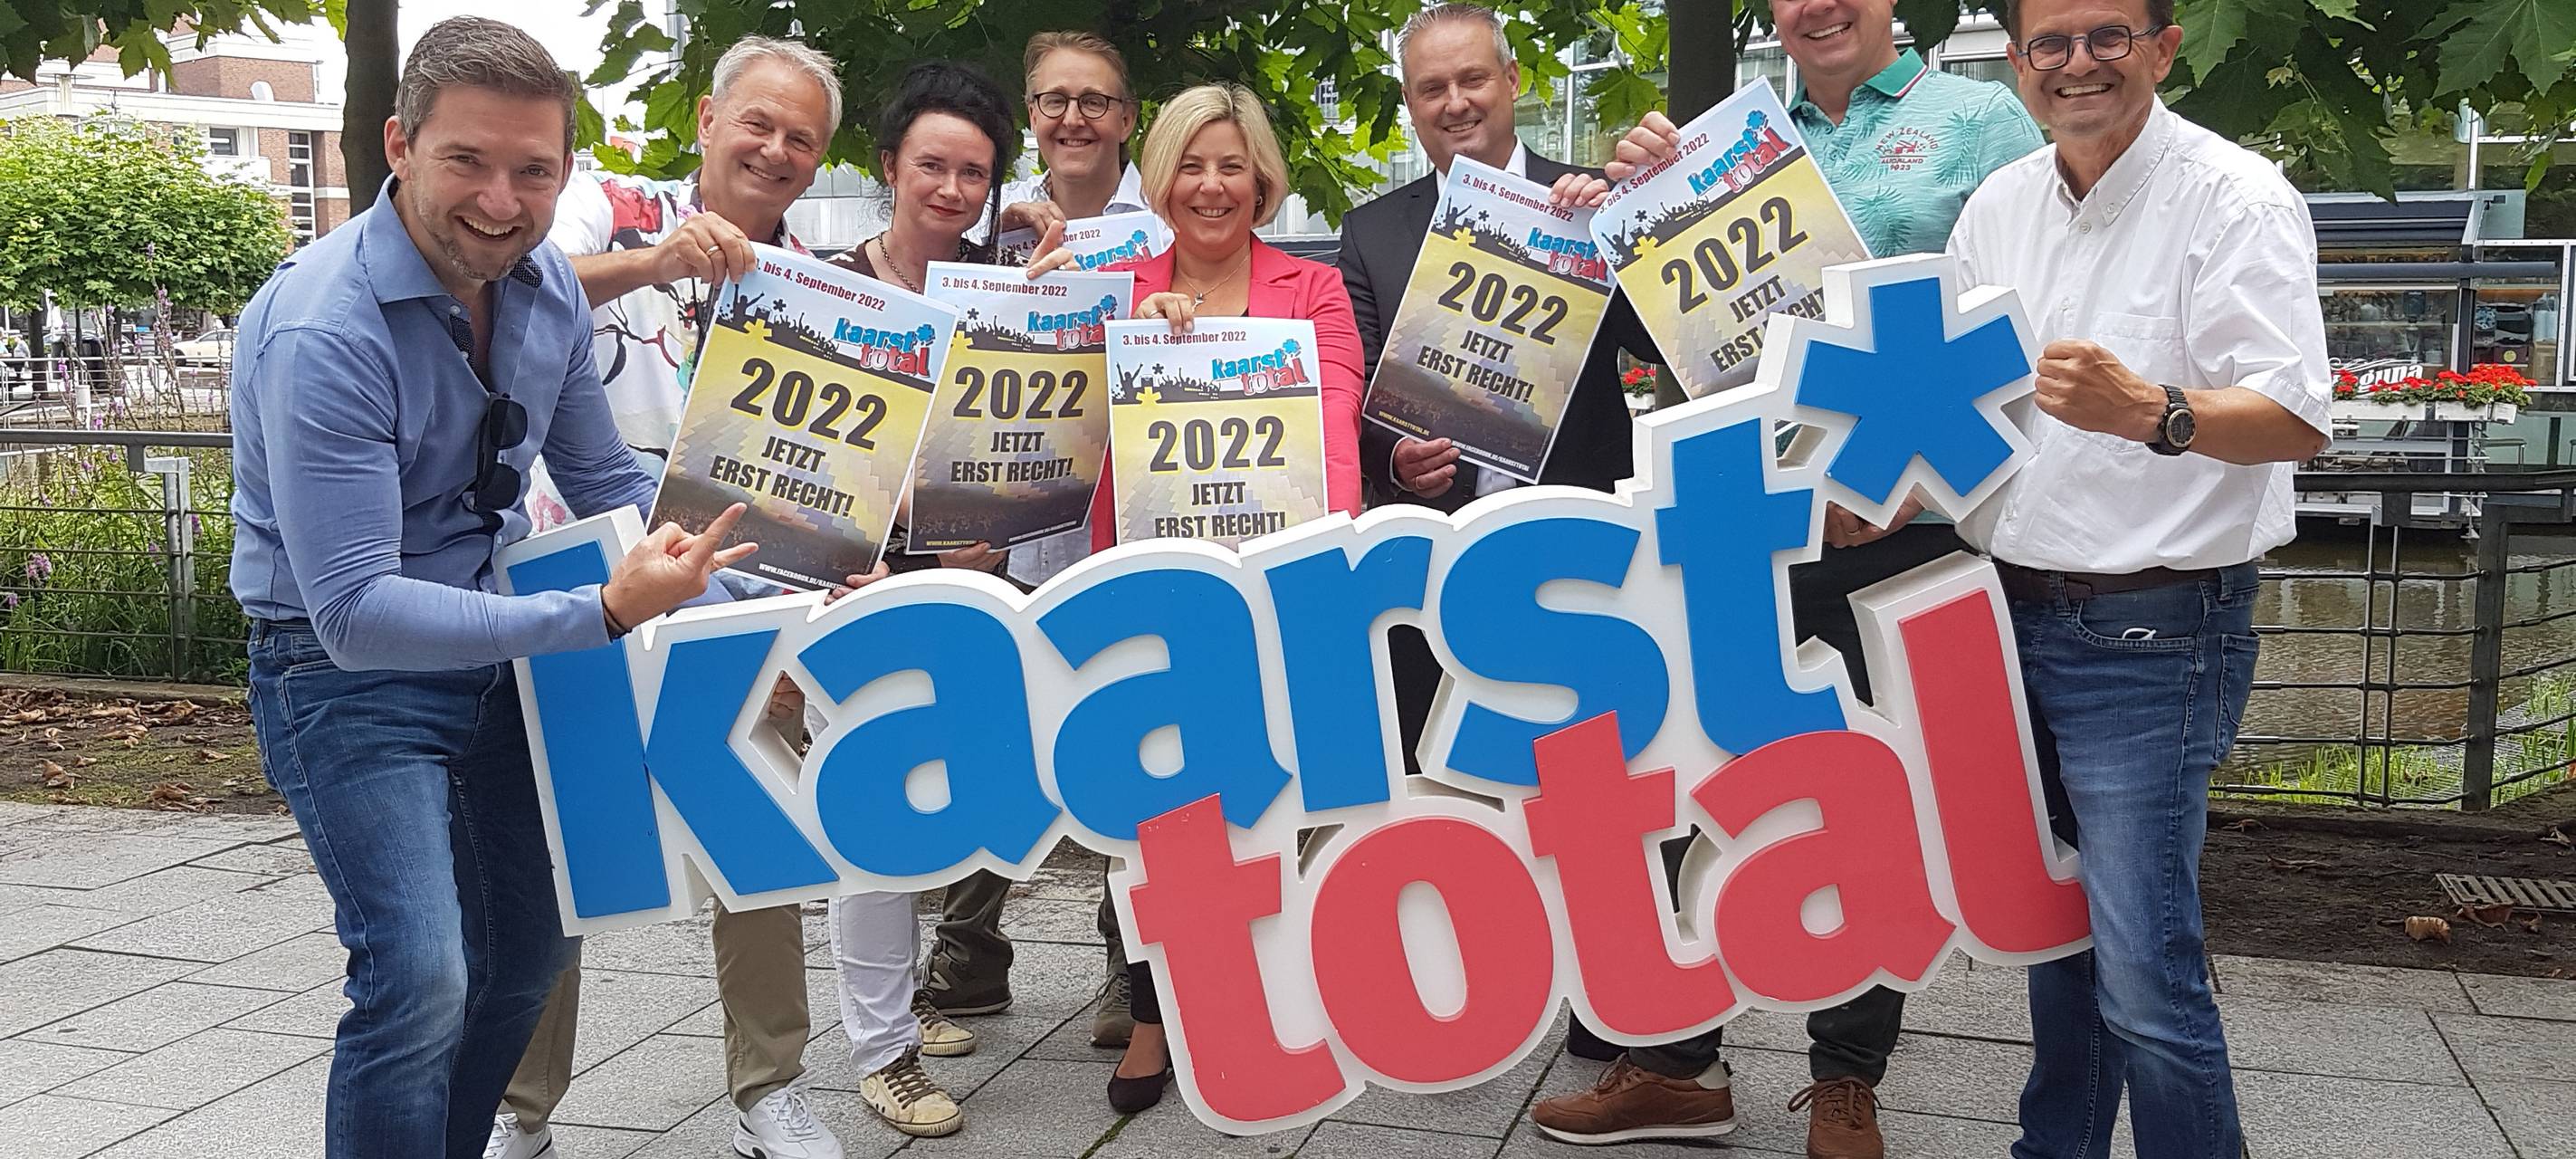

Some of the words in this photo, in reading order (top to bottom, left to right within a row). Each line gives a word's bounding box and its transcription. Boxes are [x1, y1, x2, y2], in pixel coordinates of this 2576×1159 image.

[1875, 130, 1895, 151] NEW
[1900, 127, 1939, 149] ZEALAND
[1608, 192, 1621, 207] bis
[1622, 182, 1632, 196] 4.
[1630, 151, 1684, 189] September
[1683, 133, 1710, 155] 2022
[1687, 129, 1764, 196] kaarst
[1722, 126, 1792, 193] total
[1463, 174, 1471, 186] 3.
[1473, 177, 1488, 191] bis
[1489, 183, 1496, 195] 4.
[1498, 187, 1549, 214] September
[1550, 206, 1574, 222] 2022
[1079, 228, 1101, 240] 2022
[1528, 227, 1598, 259] kaarst
[1548, 251, 1608, 282] total
[1660, 196, 1809, 314] 2022
[763, 261, 782, 276] bis
[783, 266, 793, 281] 4.
[796, 273, 857, 302] September
[858, 292, 886, 311] 2022
[942, 276, 950, 288] 3.
[953, 278, 969, 290] bis
[971, 279, 979, 291] 4.
[983, 280, 1040, 296] September
[1042, 285, 1067, 297] 2022
[1437, 261, 1569, 345] 2022
[1729, 274, 1787, 324] JETZT
[833, 317, 916, 352] kaarst
[1027, 304, 1102, 332] kaarst
[1055, 315, 1114, 350] tota
[1122, 334, 1132, 346] 3.
[1134, 333, 1150, 345] bis
[1151, 333, 1161, 345] 4.
[1163, 331, 1219, 346] September
[1222, 330, 1246, 341] 2022
[1459, 330, 1513, 363] JETZT
[1710, 326, 1764, 373] ERST
[860, 343, 930, 378] total
[1211, 347, 1285, 381] kaarst
[1241, 357, 1309, 396] total
[1417, 346, 1466, 379] ERST
[1465, 363, 1534, 404] RECHT!
[730, 357, 889, 451] 2022
[952, 366, 1089, 420] 2022
[761, 435, 826, 474] JETZT
[990, 431, 1045, 453] JETZT
[1148, 415, 1286, 473] 2022
[709, 455, 770, 493] ERST
[771, 478, 855, 518] RECHT!
[950, 460, 1002, 483] ERST
[1006, 457, 1073, 483] RECHT!
[1191, 481, 1246, 506] JETZT
[1154, 515, 1206, 538] ERST
[1212, 512, 1286, 537] RECHT!
[506, 417, 1851, 918] kaarst
[1129, 592, 2090, 1123] total
